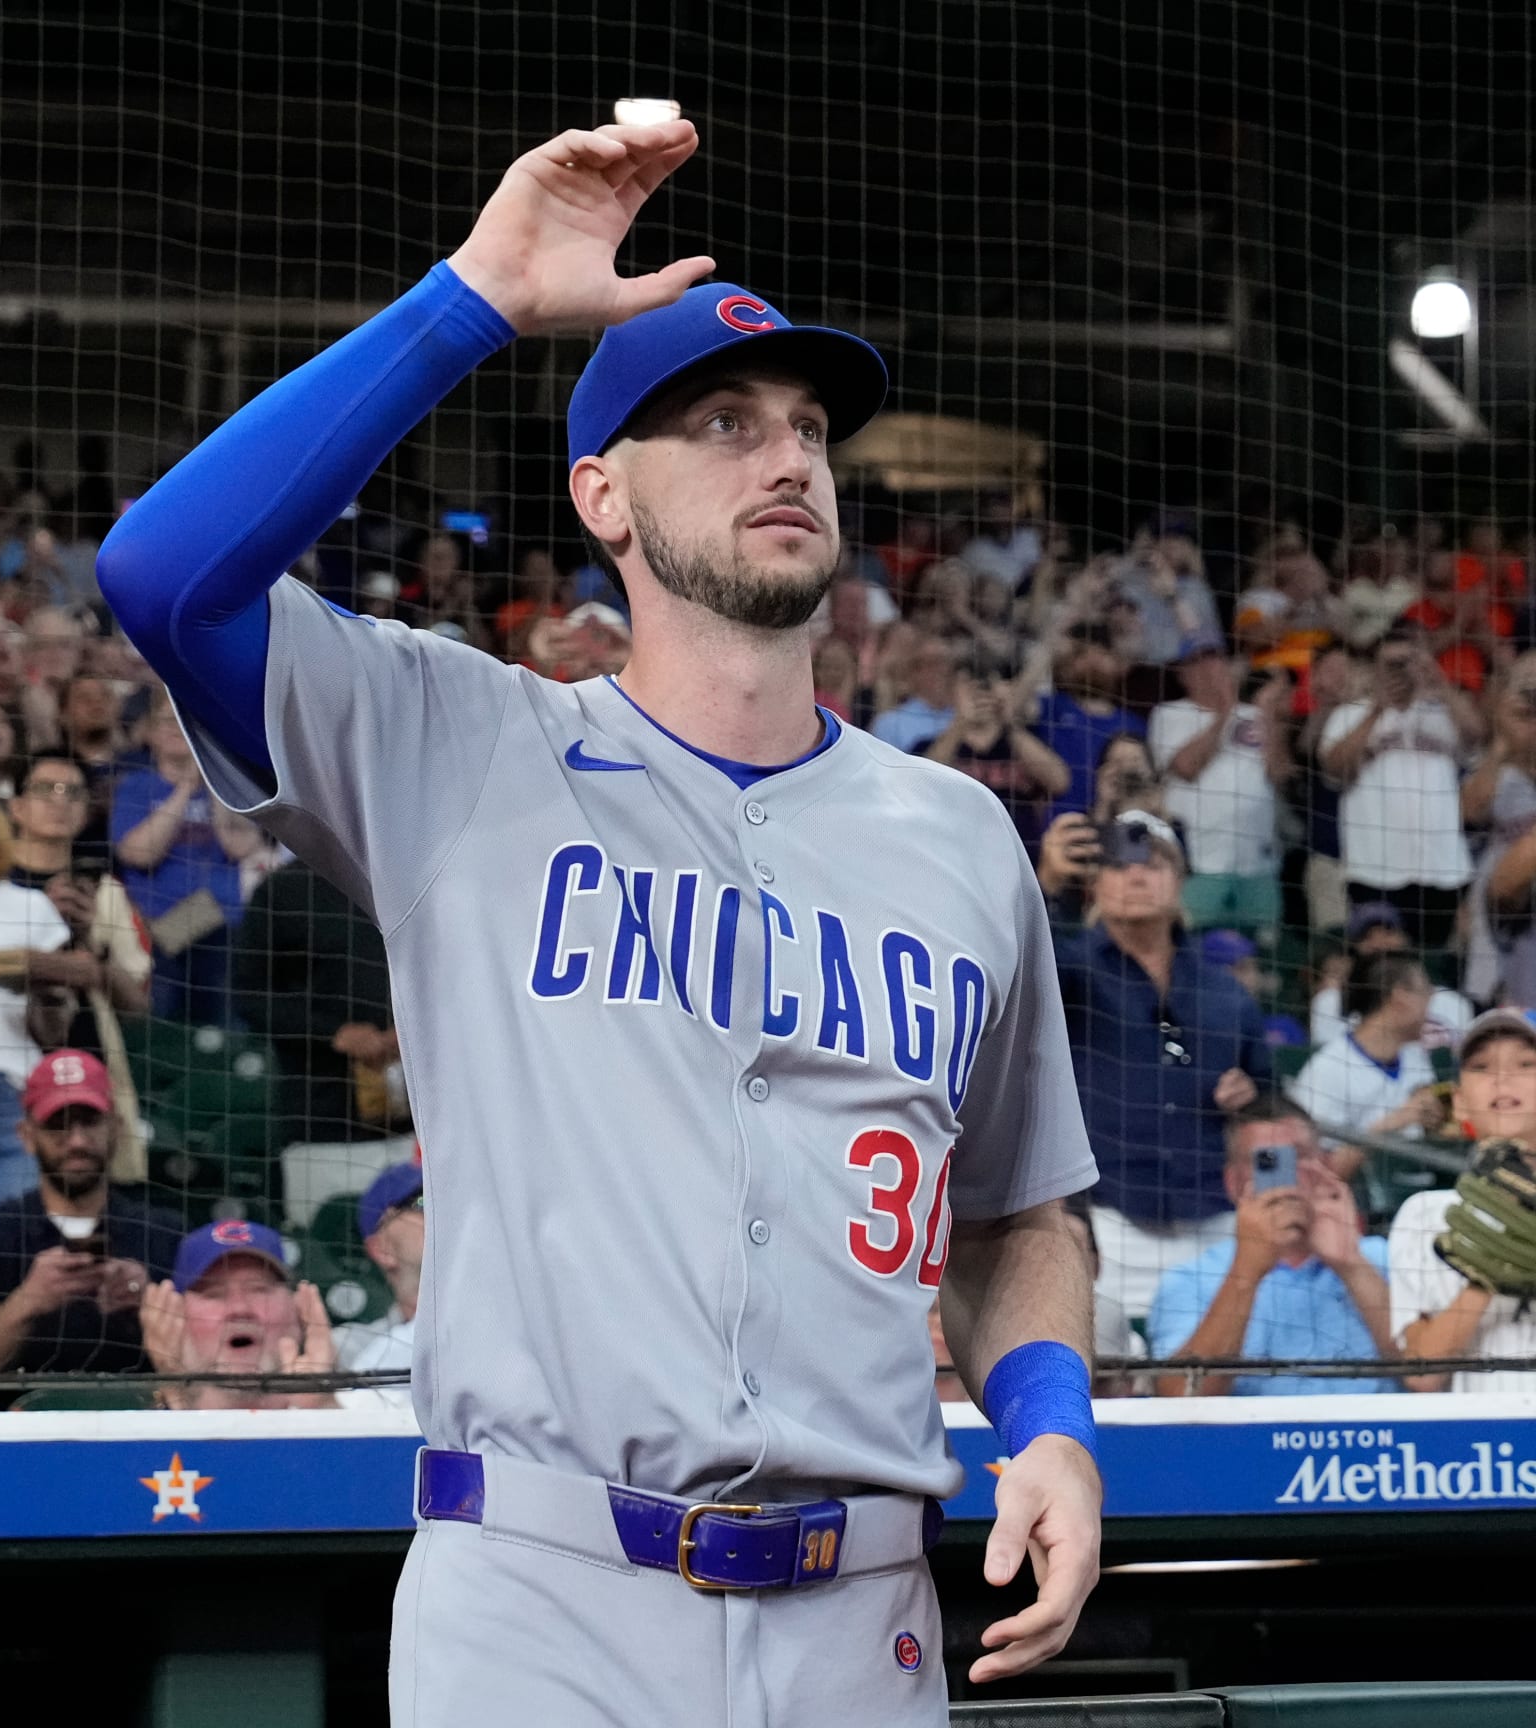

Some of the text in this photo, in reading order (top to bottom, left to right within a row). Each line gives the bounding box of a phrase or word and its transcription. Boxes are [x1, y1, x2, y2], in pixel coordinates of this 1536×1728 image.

[716, 295, 776, 334] C
[527, 840, 987, 1118] CHICAGO
[845, 1125, 952, 1291] 30
[211, 1219, 253, 1245] C
[1272, 1429, 1394, 1449] HOUSTON
[152, 1470, 201, 1514] H
[1274, 1442, 1536, 1504] Methodis
[803, 1529, 837, 1571] 30
